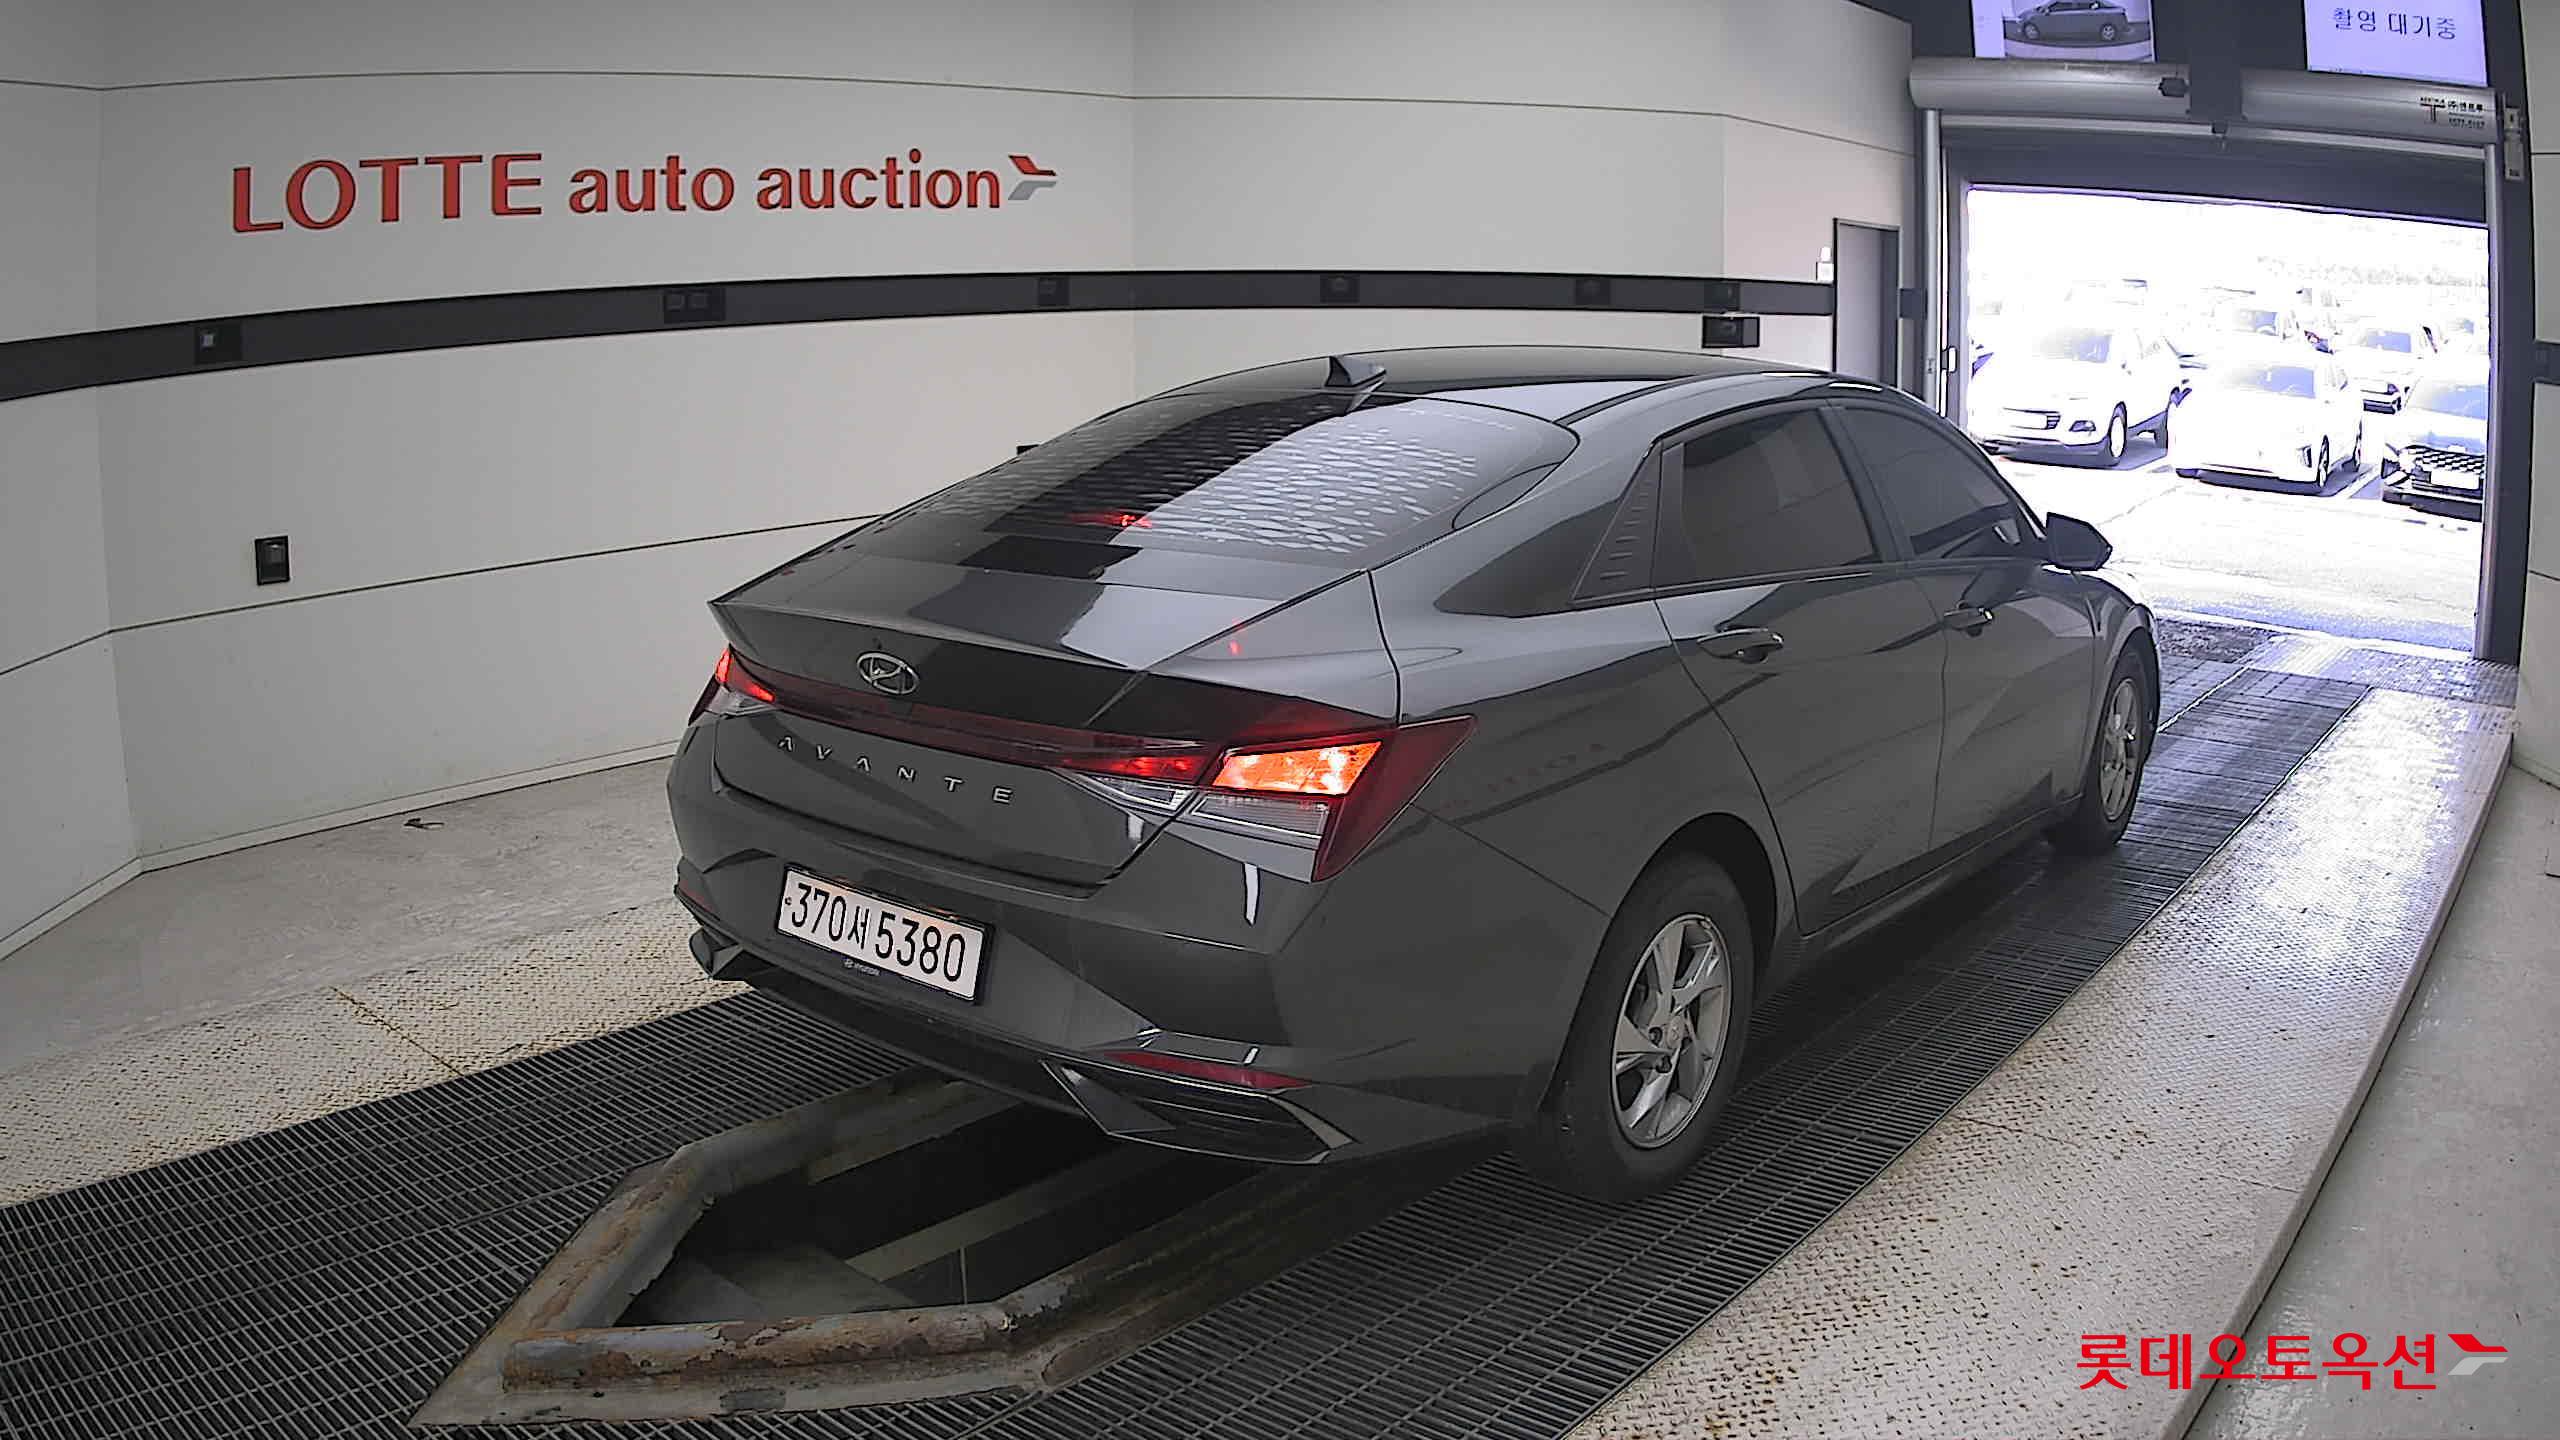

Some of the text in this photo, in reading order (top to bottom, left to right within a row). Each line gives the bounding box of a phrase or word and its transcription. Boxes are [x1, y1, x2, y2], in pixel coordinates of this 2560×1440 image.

[2388, 13, 2456, 40] 대기중
[233, 147, 1002, 233] LOTTE auto auction
[779, 736, 1012, 804] AVANTE
[791, 882, 965, 982] 370서5380
